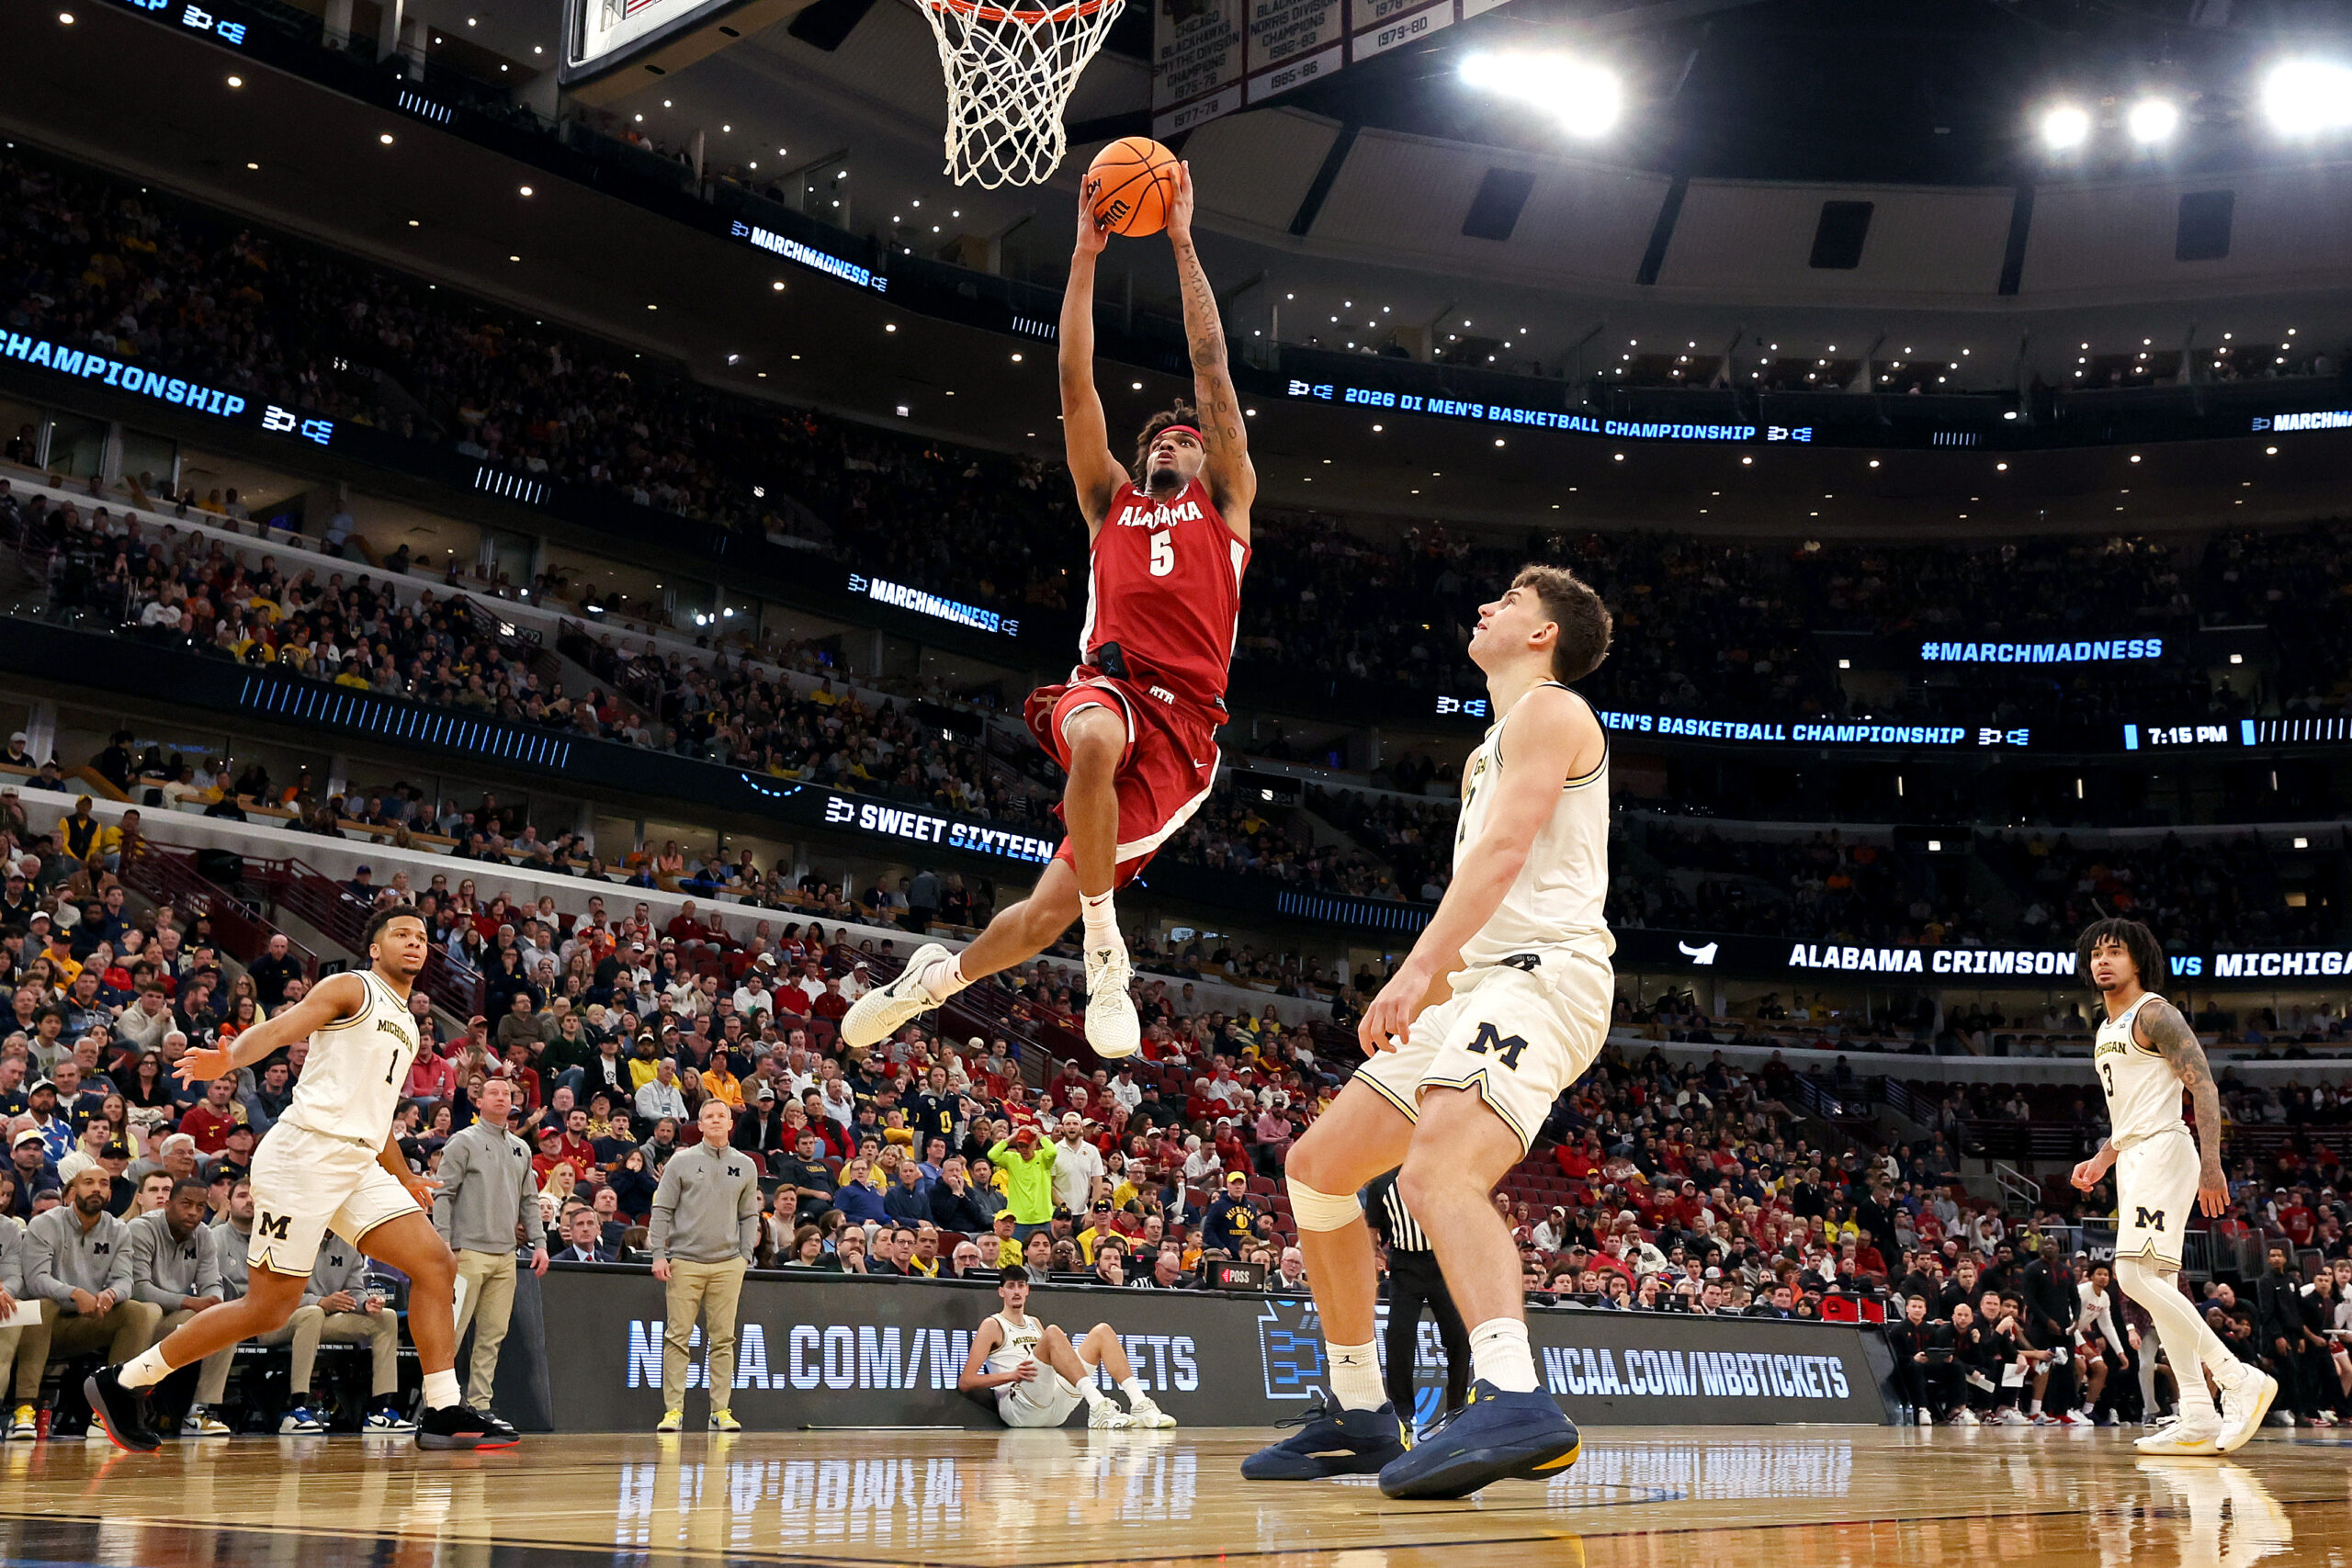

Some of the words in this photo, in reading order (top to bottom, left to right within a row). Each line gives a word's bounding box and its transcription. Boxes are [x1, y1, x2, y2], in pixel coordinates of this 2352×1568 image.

[1250, 12, 1289, 36] NORRIS
[1262, 12, 1325, 47] CHAMPIONS
[1378, 17, 1428, 47] 1979-80
[1197, 31, 1240, 60] DIVISION
[1167, 53, 1227, 87] CHAMPIONS
[751, 226, 870, 288] MARCHMADNESS
[1345, 388, 1396, 408] 2026
[1400, 395, 1423, 411] DI
[1428, 399, 1484, 418] MEN'S
[1488, 405, 1600, 434] BASKETBALL
[1604, 420, 1756, 442] CHAMPIONSHIP
[1116, 501, 1204, 529] ALABAMA
[1149, 529, 1175, 577] 5
[869, 579, 1000, 633] MARCHMADNESS
[1921, 638, 2163, 663] #MARCHMADNESS
[1148, 685, 1176, 705] RTR
[1657, 716, 1785, 740] BASKETBALL
[1792, 724, 1965, 744] CHAMPIONSHIP
[2148, 728, 2192, 745] 7:15
[2196, 727, 2227, 744] PM
[859, 804, 947, 843] SWEET
[949, 823, 1054, 864] SIXTEEN
[1789, 944, 1923, 972] ALABAMA
[1932, 951, 2075, 976] CRIMSON
[2171, 956, 2202, 976] VS
[1466, 1021, 1529, 1073] M
[385, 1048, 399, 1086] 1
[2102, 1063, 2114, 1098] 3
[939, 1110, 953, 1134] 0
[258, 1212, 293, 1240] M
[2134, 1206, 2165, 1233] M
[1229, 1269, 1250, 1283] POSS
[1542, 1346, 1850, 1399] NCAA.COM/MBBTICKETS
